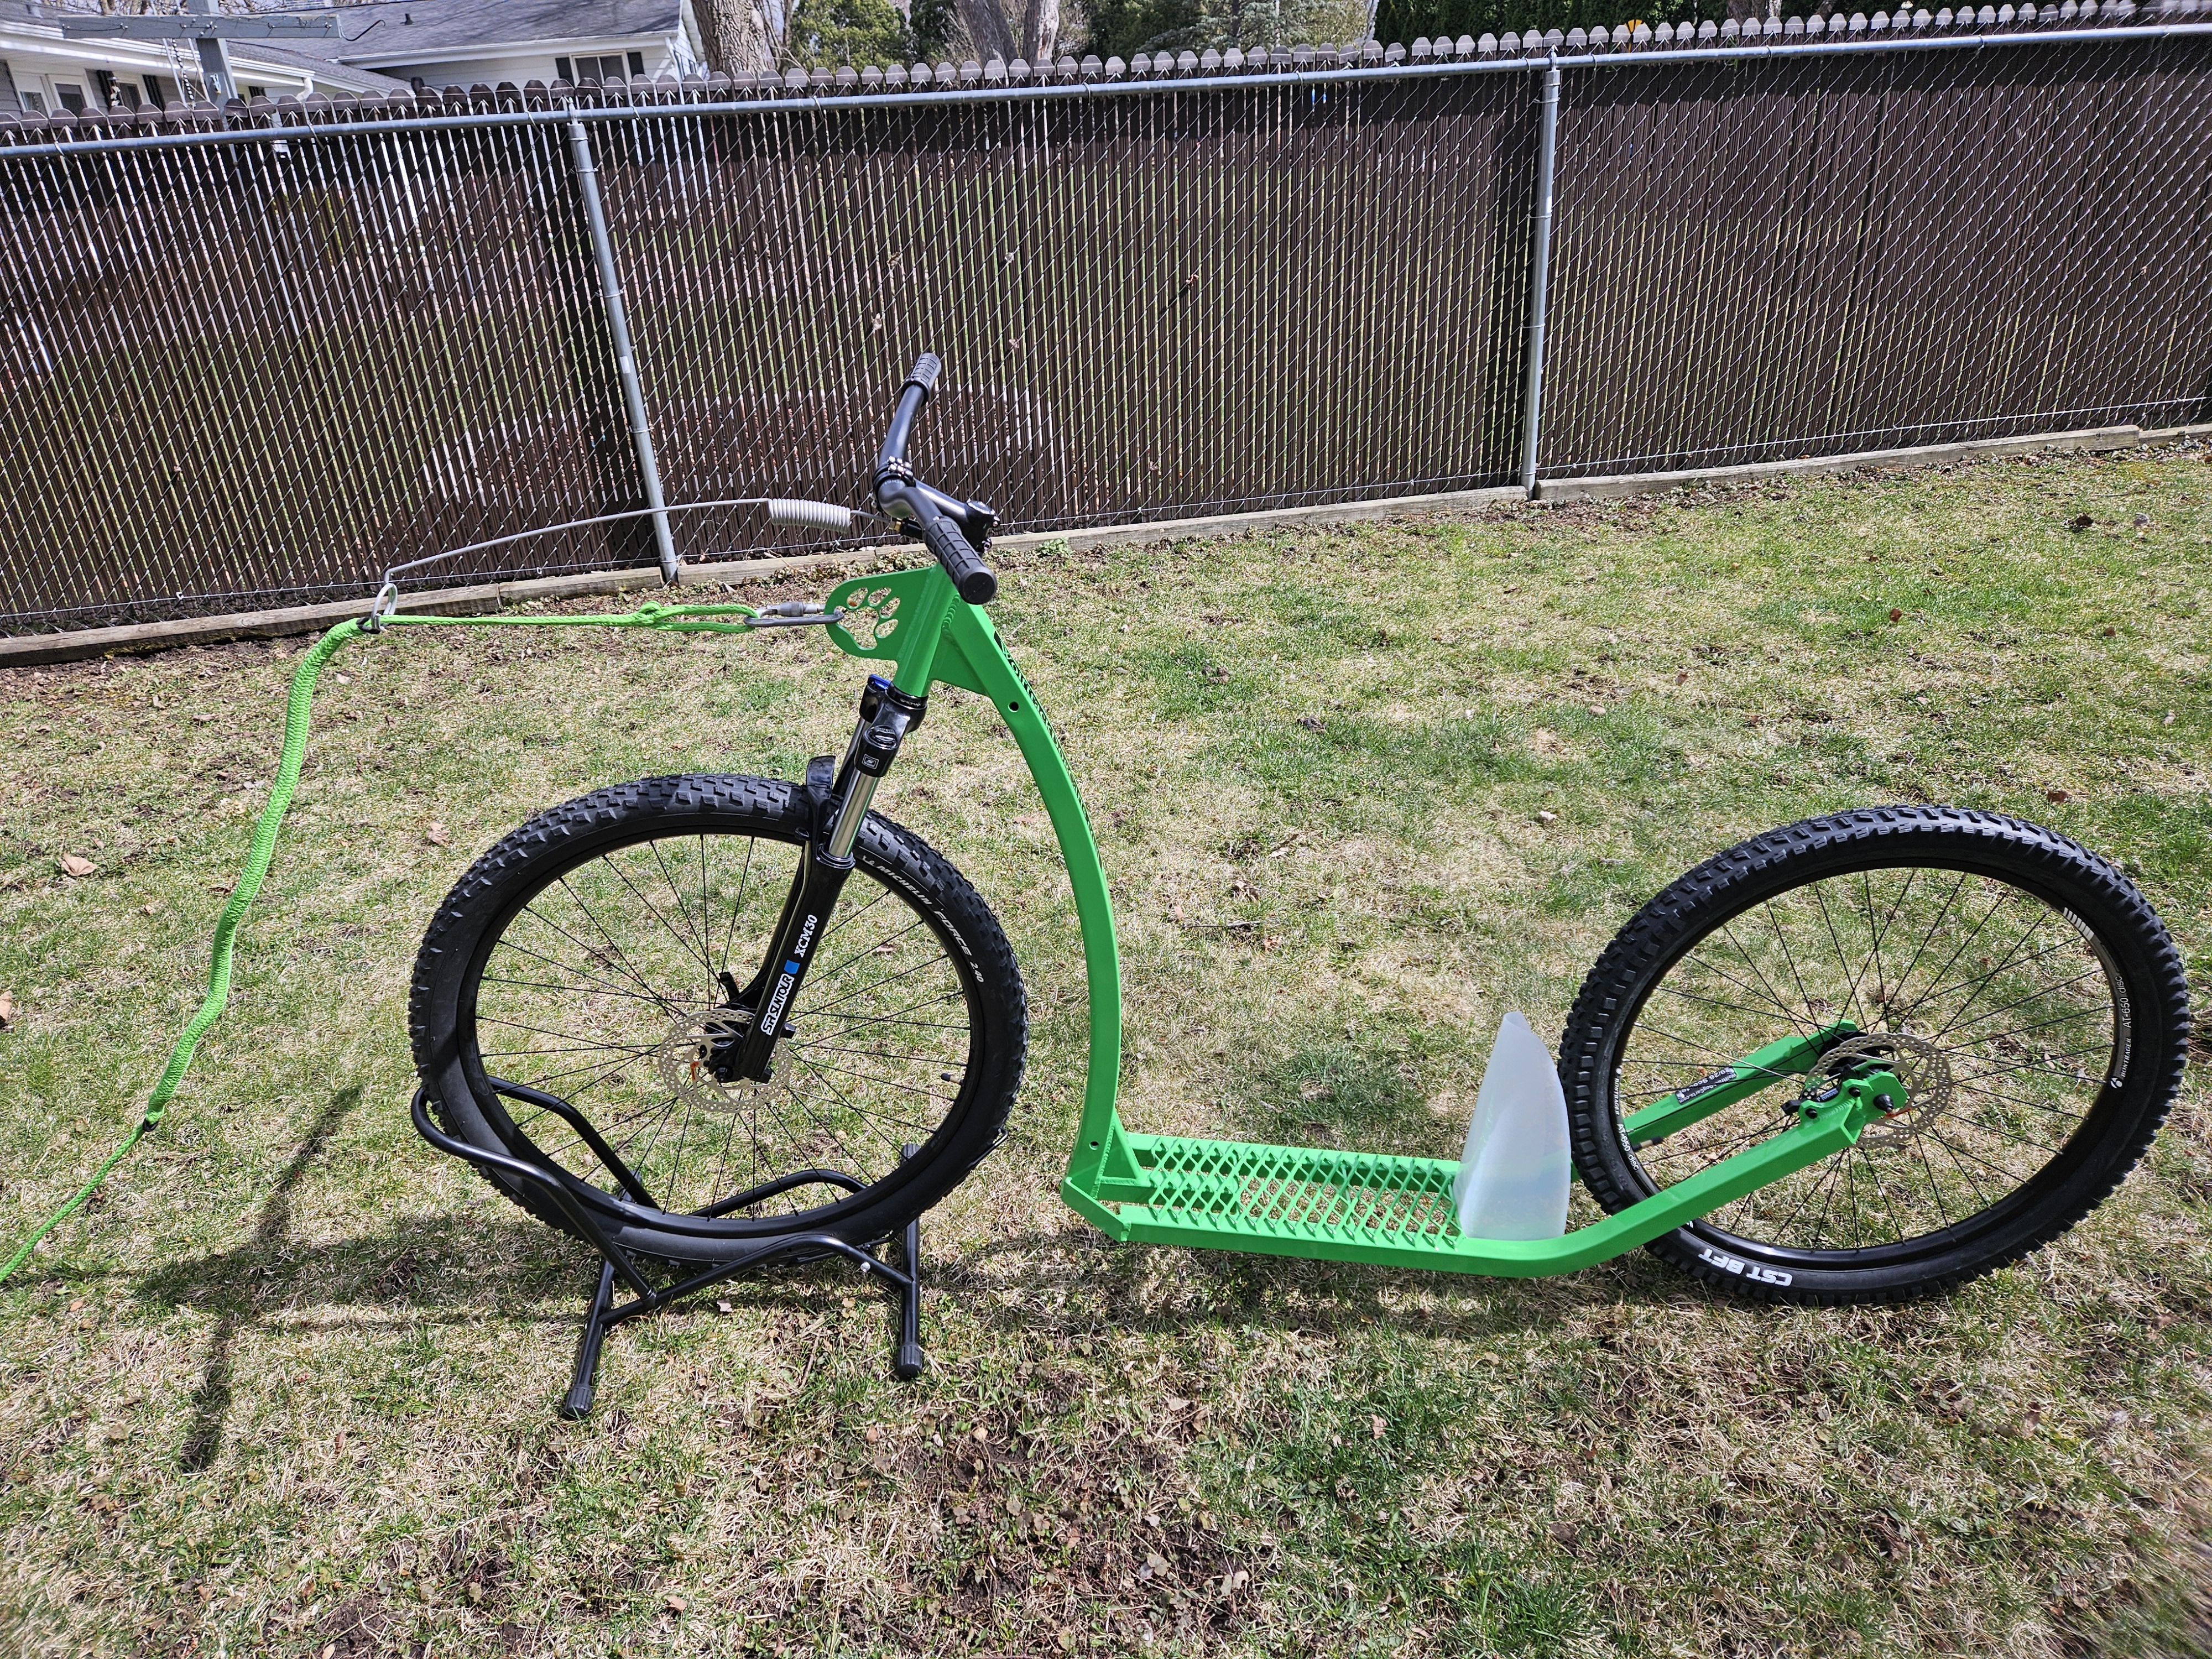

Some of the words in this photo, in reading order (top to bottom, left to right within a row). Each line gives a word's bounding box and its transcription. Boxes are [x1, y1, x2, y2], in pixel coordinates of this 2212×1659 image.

[877, 865, 932, 905] MICHELIN
[933, 911, 972, 956] FORCE
[794, 914, 817, 958] XCM30
[2115, 976, 2126, 994] disc
[762, 1014, 776, 1035] SR
[769, 974, 794, 1018] SUNTOUR
[2120, 998, 2132, 1028] AT-650
[2120, 1037, 2131, 1078] BONTRAGER
[1679, 1077, 1708, 1094] Scoe
[1616, 1124, 1631, 1152] AT-650
[1628, 1154, 1640, 1171] disc
[1698, 1248, 1746, 1274] BFT
[1746, 1265, 1793, 1286] CST
